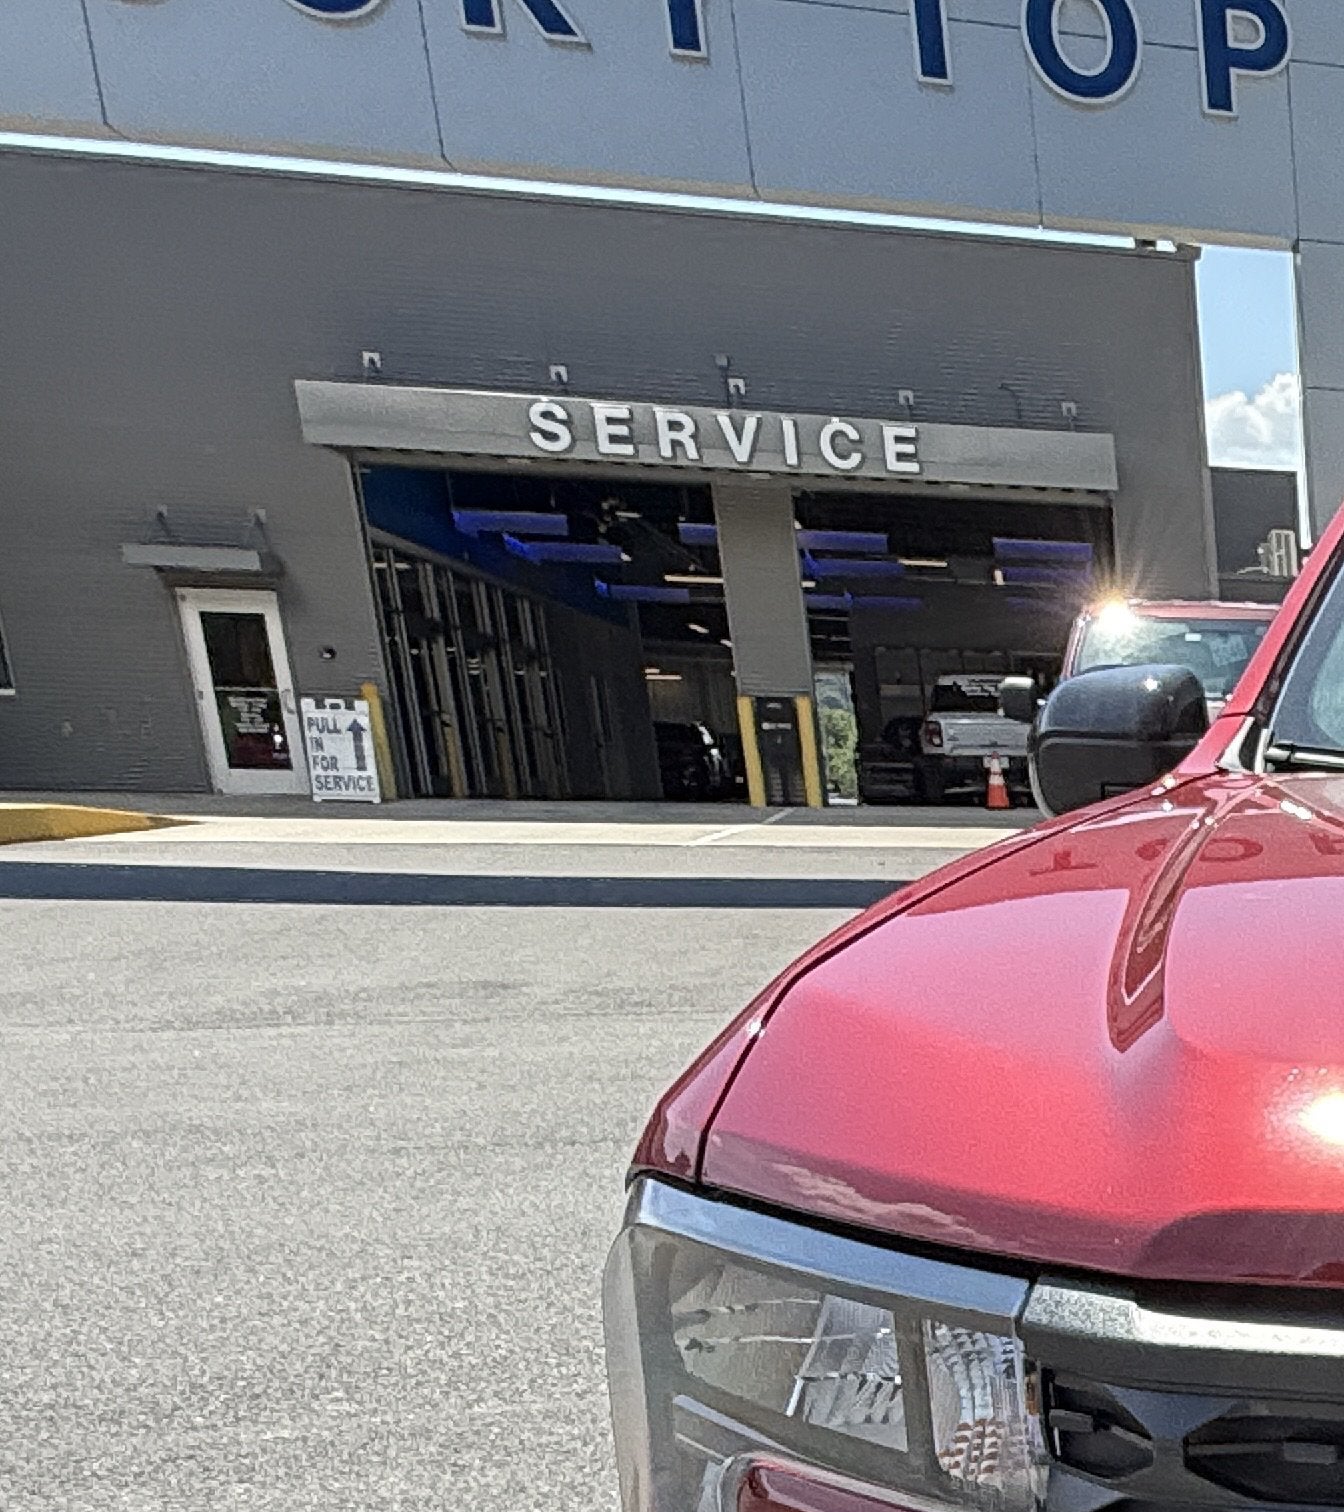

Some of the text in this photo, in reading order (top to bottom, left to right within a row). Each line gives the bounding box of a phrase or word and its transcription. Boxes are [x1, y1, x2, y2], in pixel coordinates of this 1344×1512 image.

[528, 400, 921, 473] SERVICE
[307, 716, 342, 734] PULL
[310, 736, 324, 752] IN
[312, 755, 340, 772] FOR
[315, 775, 376, 793] SERVICE
